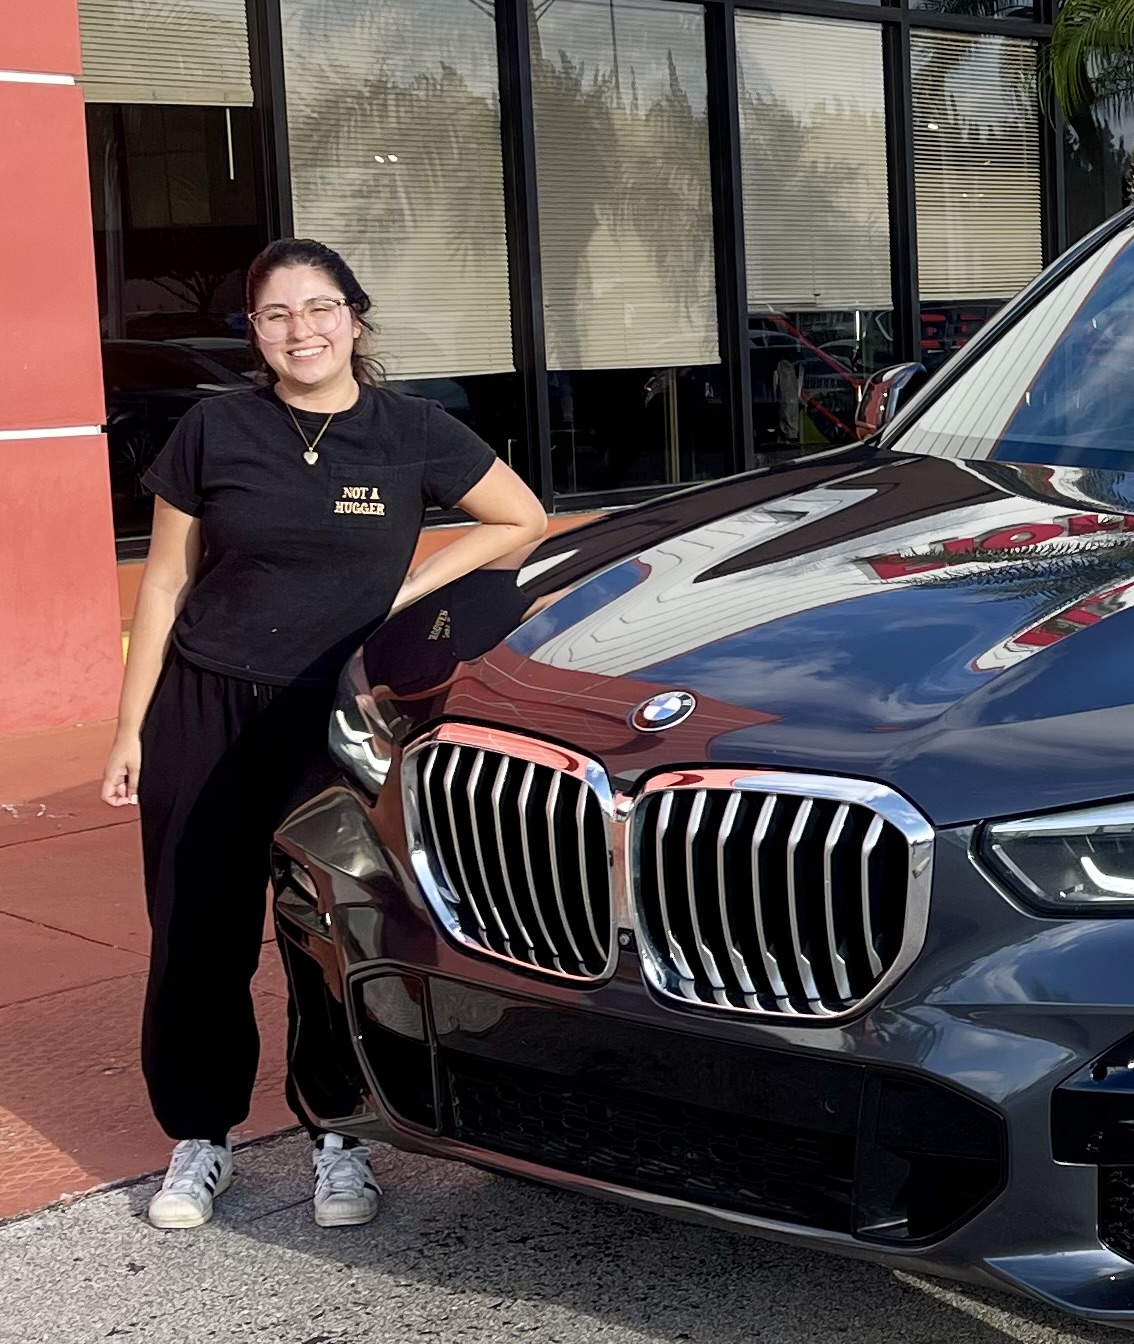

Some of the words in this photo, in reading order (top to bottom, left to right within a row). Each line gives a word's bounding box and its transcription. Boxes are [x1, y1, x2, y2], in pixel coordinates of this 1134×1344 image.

[341, 486, 369, 500] NOT
[369, 487, 381, 500] A
[333, 500, 386, 516] HUGGER
